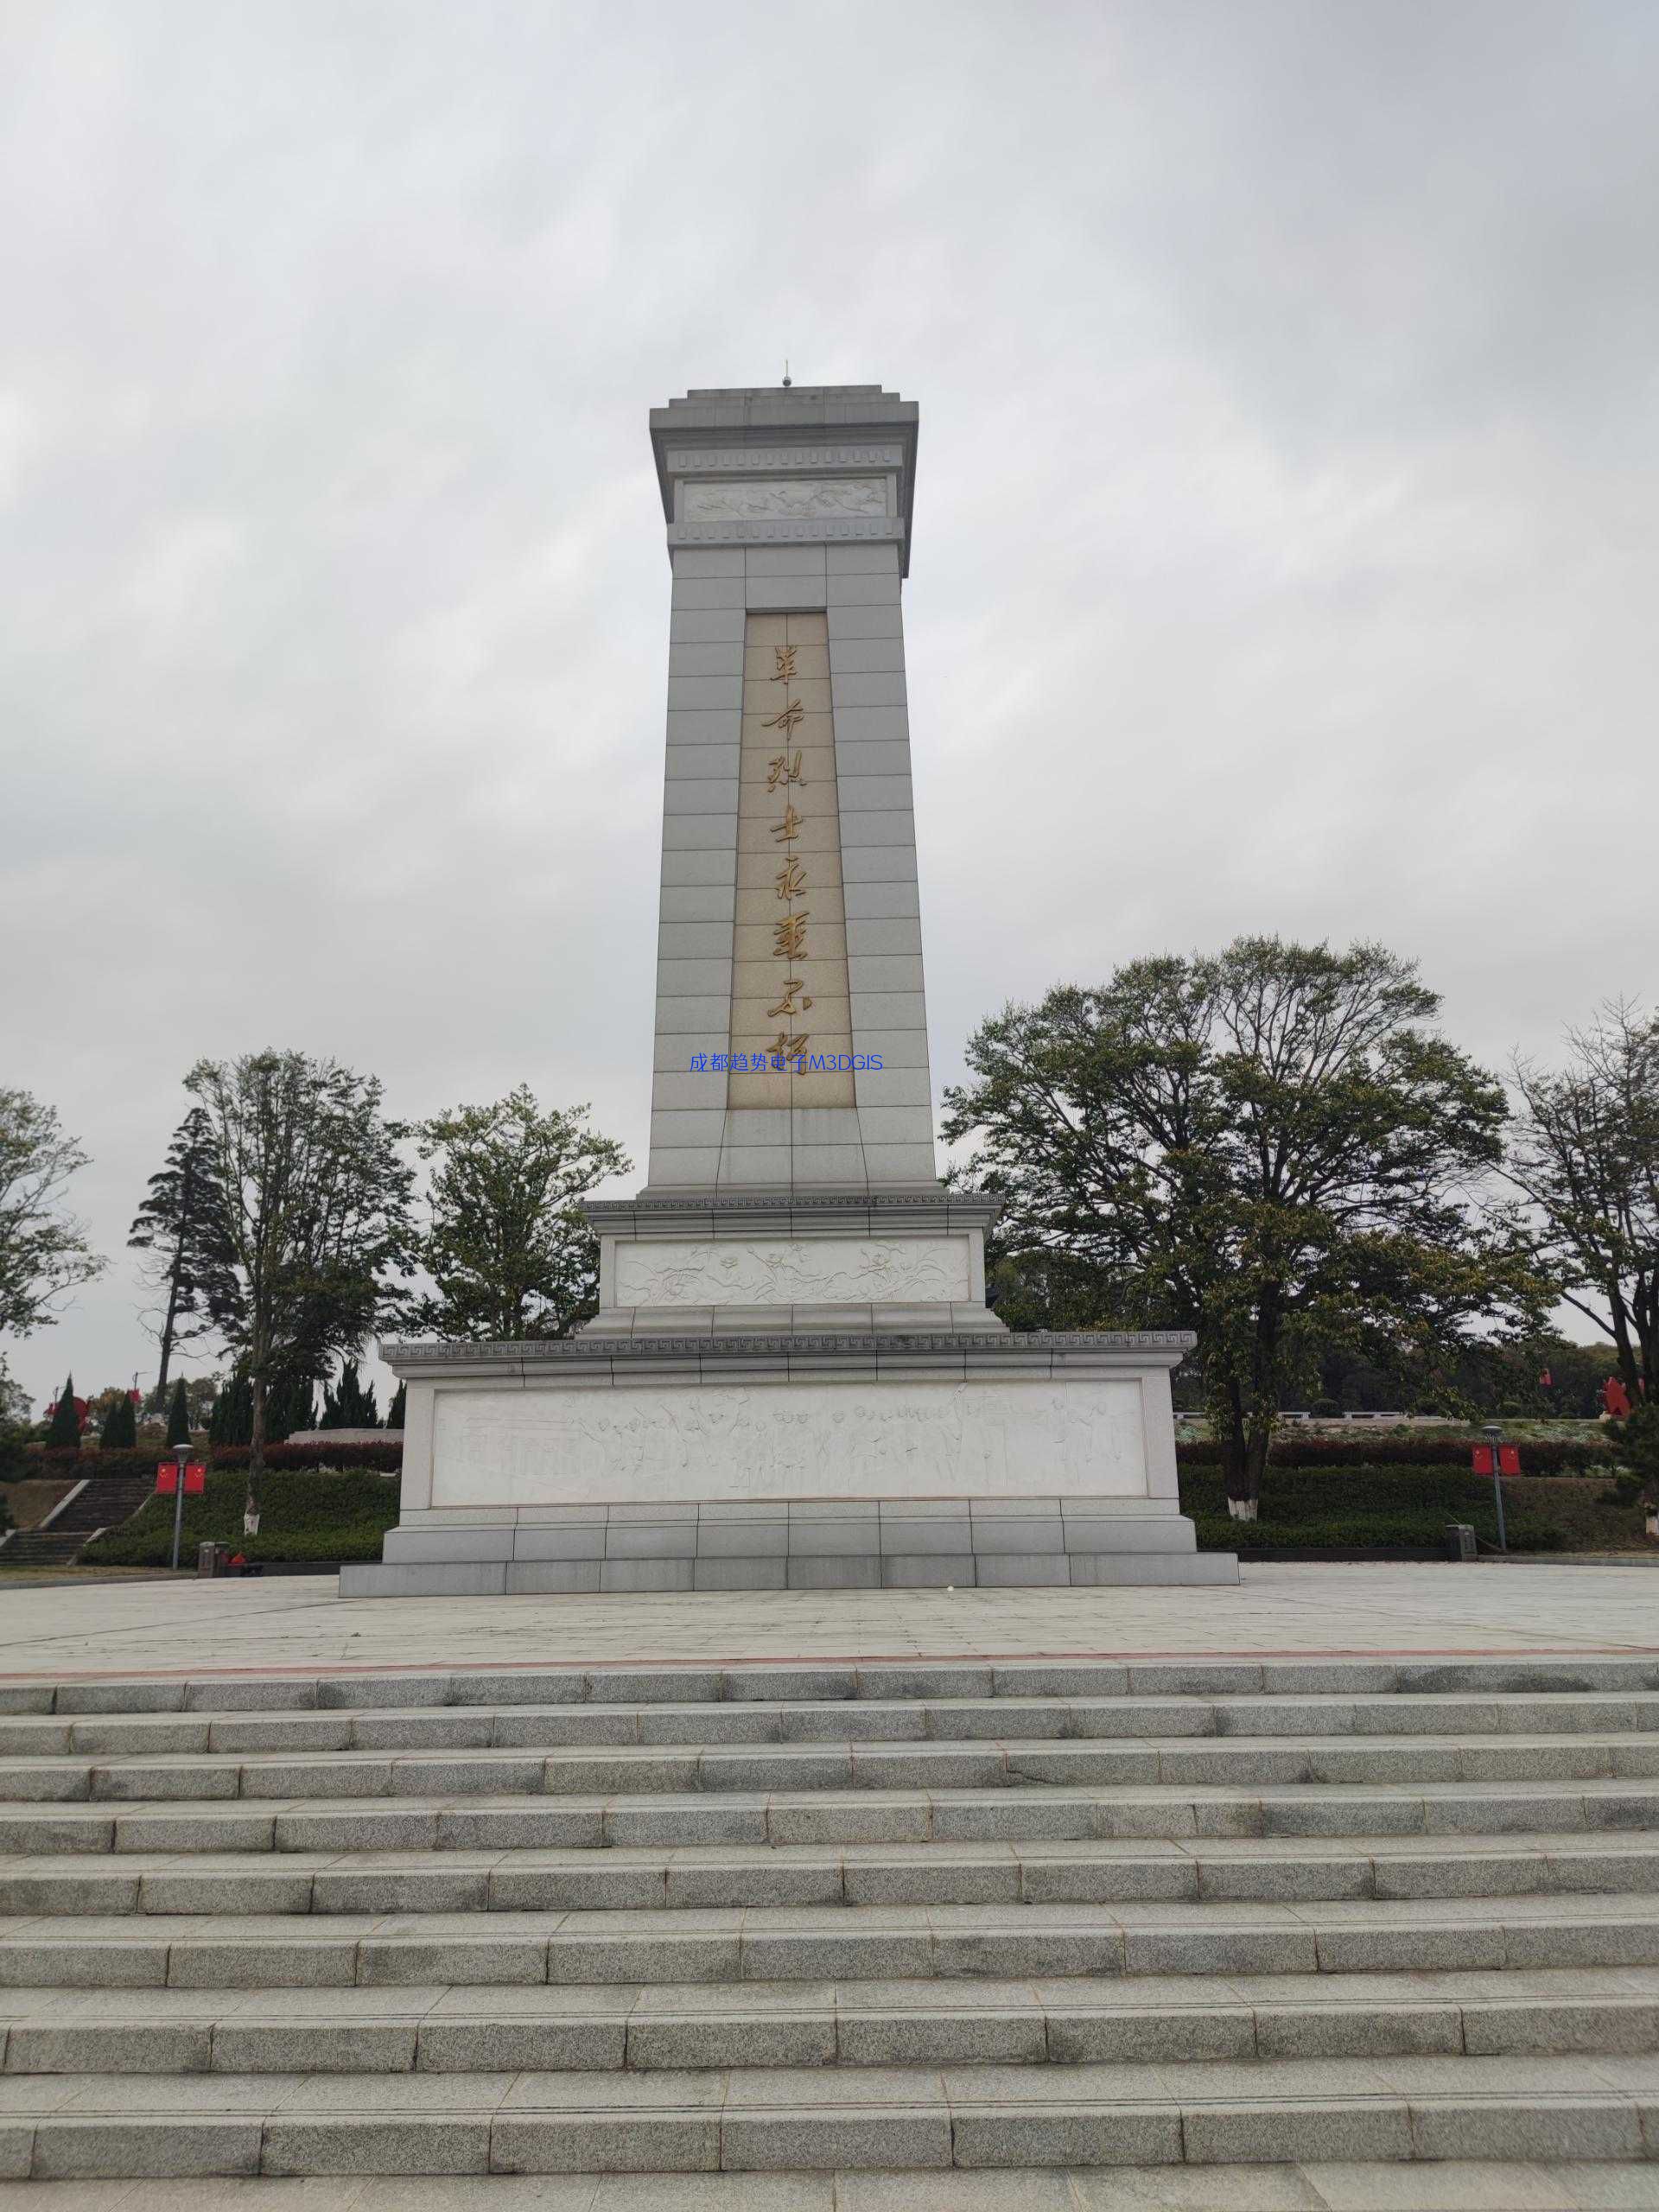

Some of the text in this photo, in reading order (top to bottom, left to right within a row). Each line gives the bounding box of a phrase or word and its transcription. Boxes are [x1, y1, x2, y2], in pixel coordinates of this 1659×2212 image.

[762, 645, 812, 1075] 革命烈士永垂不朽
